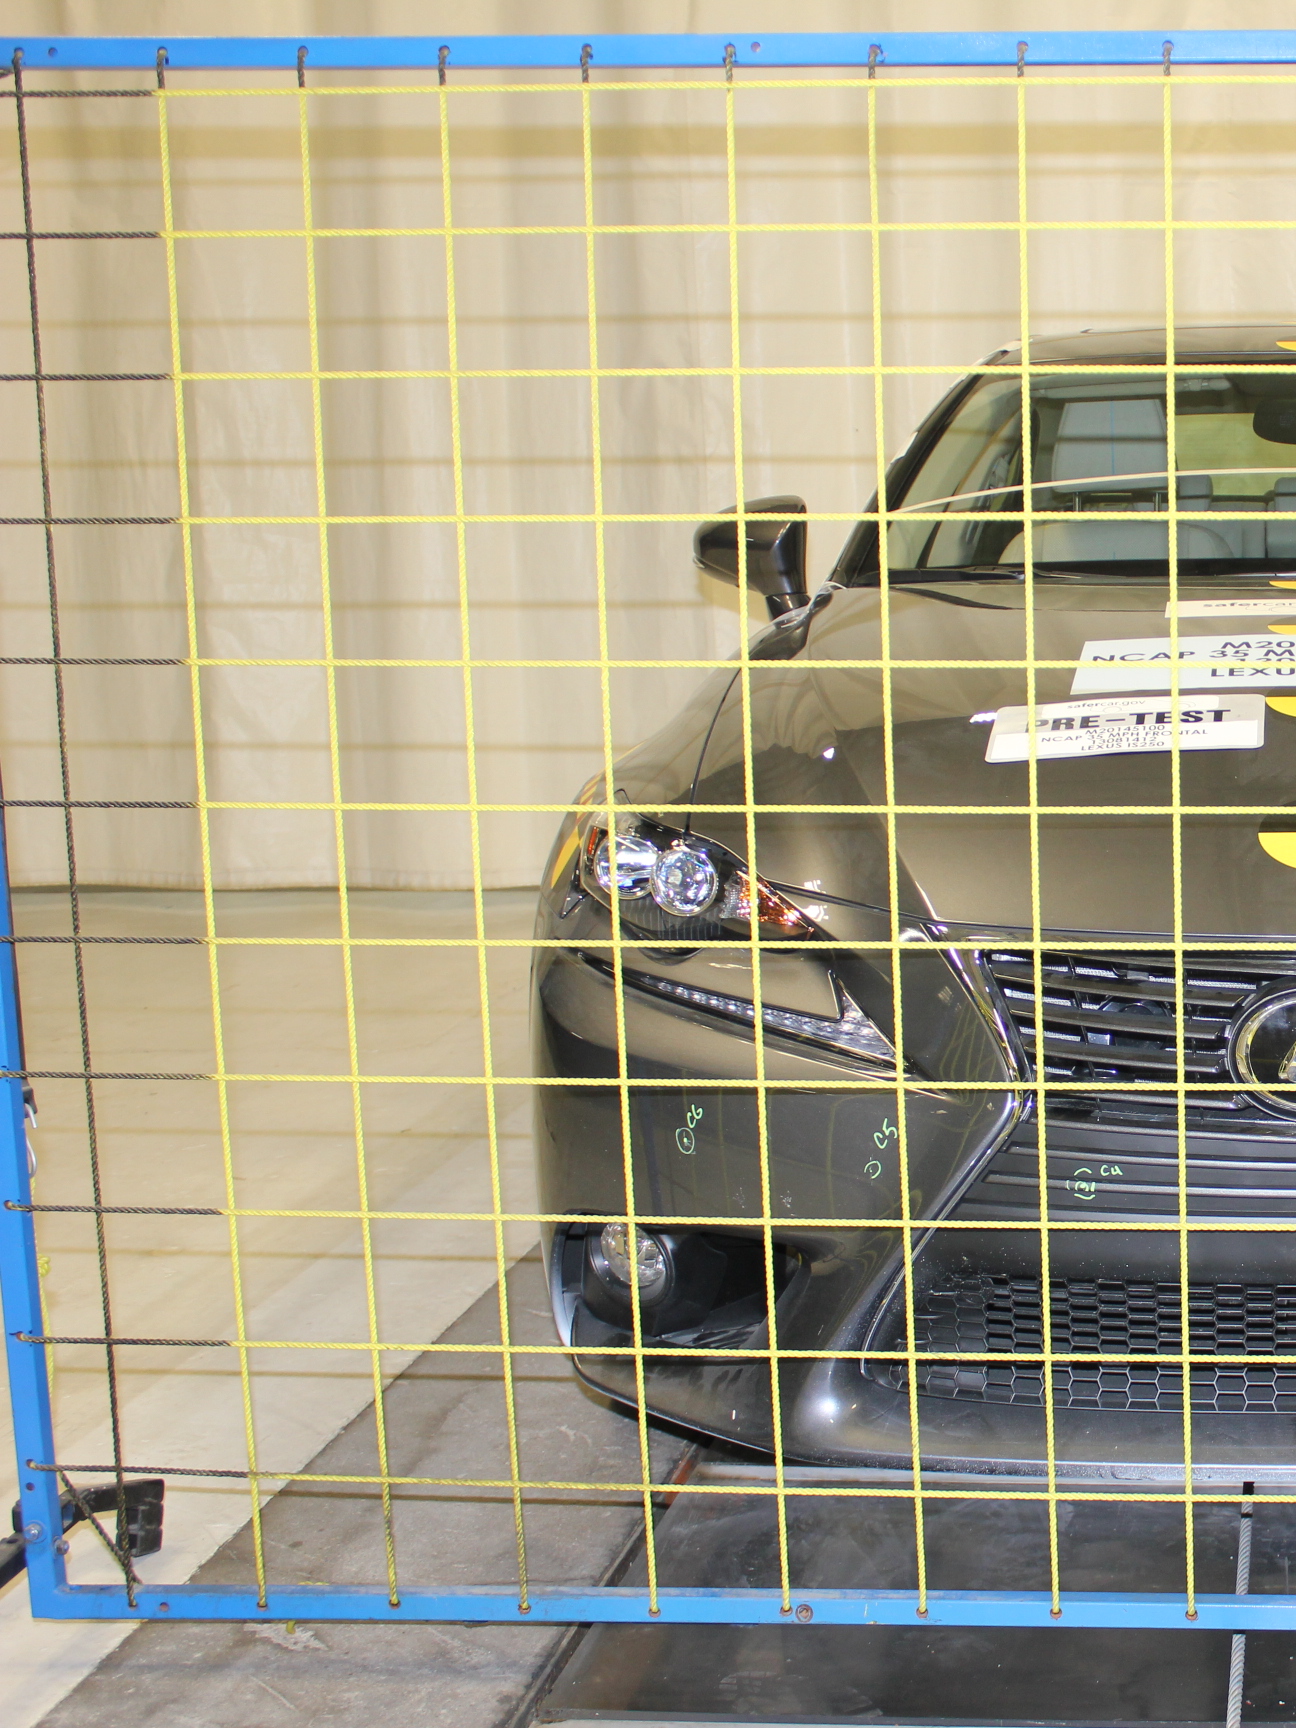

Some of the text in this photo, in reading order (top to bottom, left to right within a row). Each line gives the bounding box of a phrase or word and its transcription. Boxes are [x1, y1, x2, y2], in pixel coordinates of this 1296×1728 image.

[1092, 651, 1196, 662] NCAP
[1208, 649, 1249, 658] 35
[1067, 699, 1146, 710] safercar.gov
[1024, 709, 1231, 733] PRE-TEST
[1085, 724, 1165, 735] M20145100
[1041, 735, 1083, 743] NCAP
[1087, 733, 1104, 741] 35
[1091, 736, 1157, 745] 13081412
[1080, 742, 1122, 751] LEXUS
[686, 1103, 703, 1128] C6
[873, 1117, 898, 1149] C5
